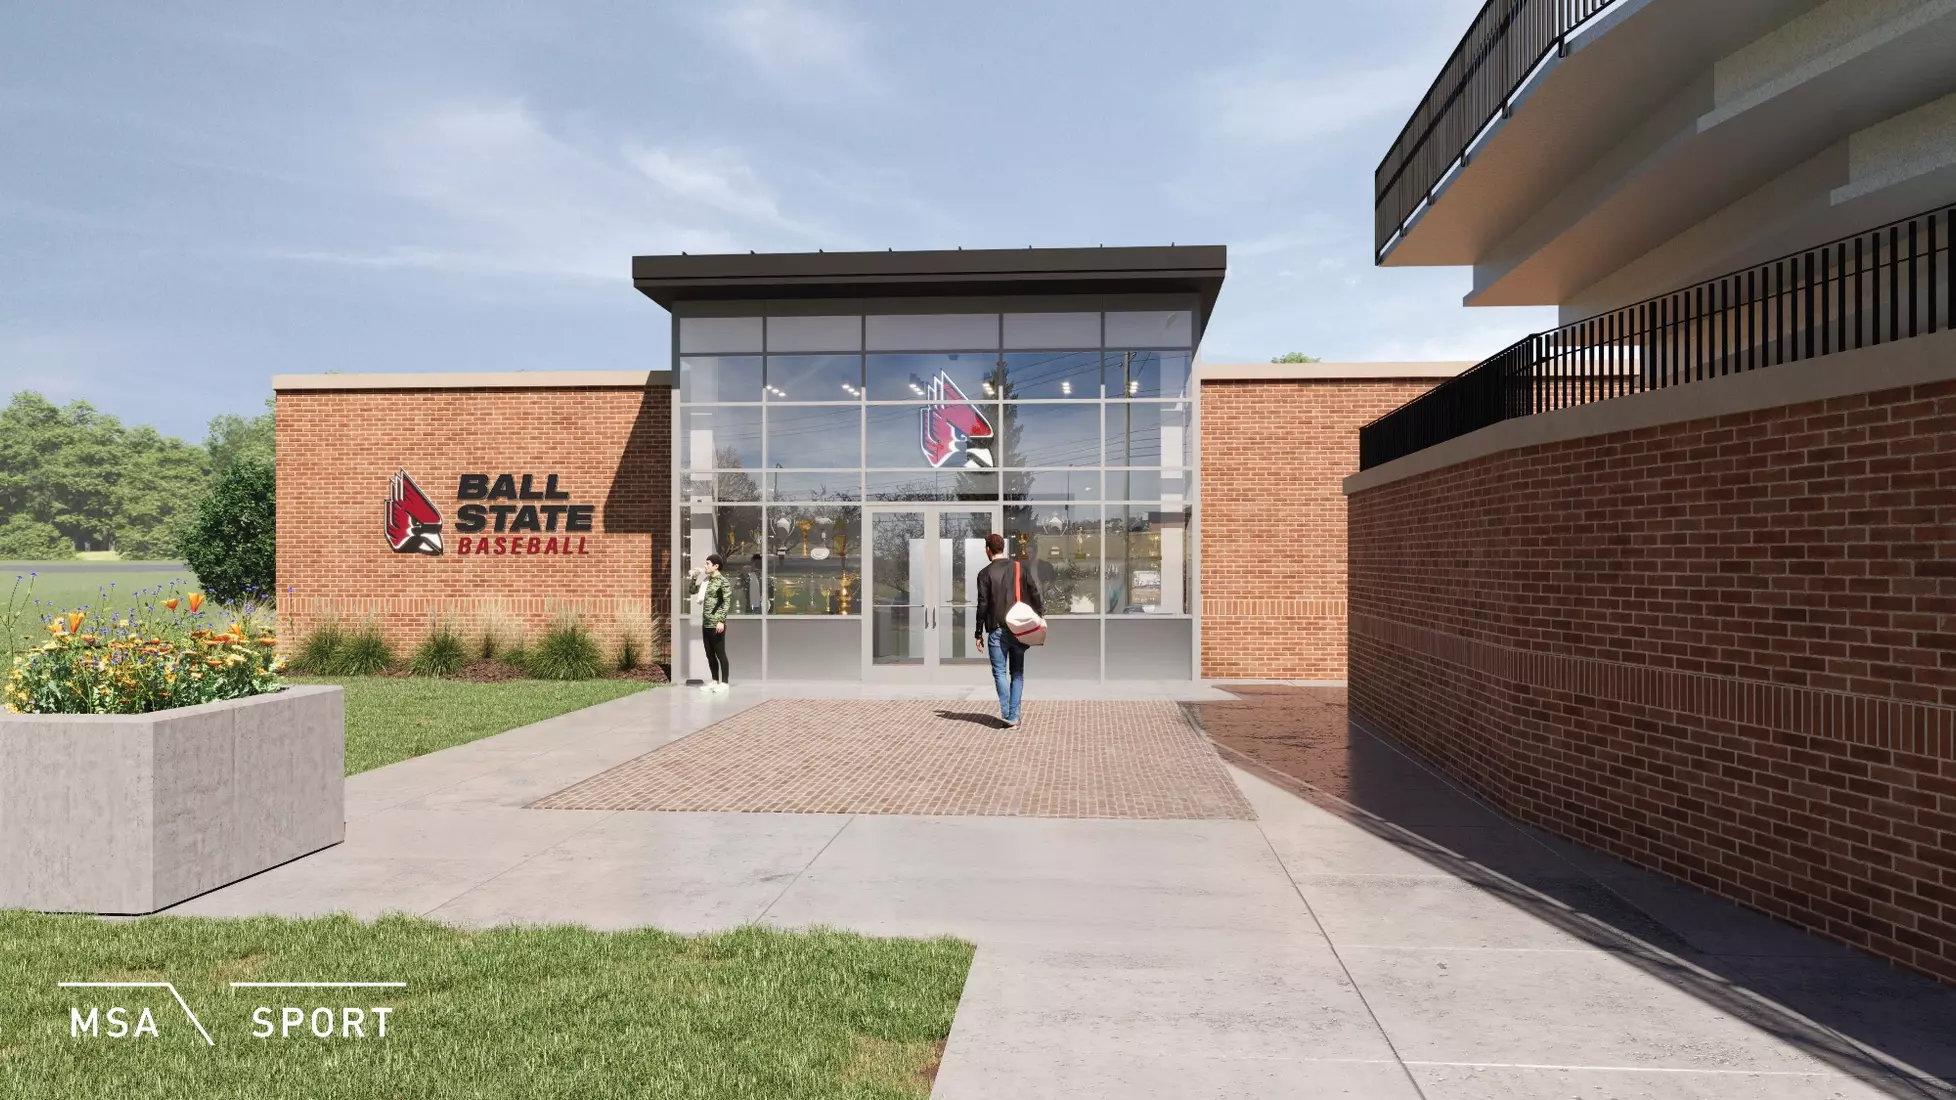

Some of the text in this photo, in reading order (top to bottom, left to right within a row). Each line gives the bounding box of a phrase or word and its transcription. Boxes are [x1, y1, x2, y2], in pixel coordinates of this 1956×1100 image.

[456, 473, 570, 500] BALL
[454, 504, 595, 533] STATE
[457, 536, 590, 555] BASEBALL
